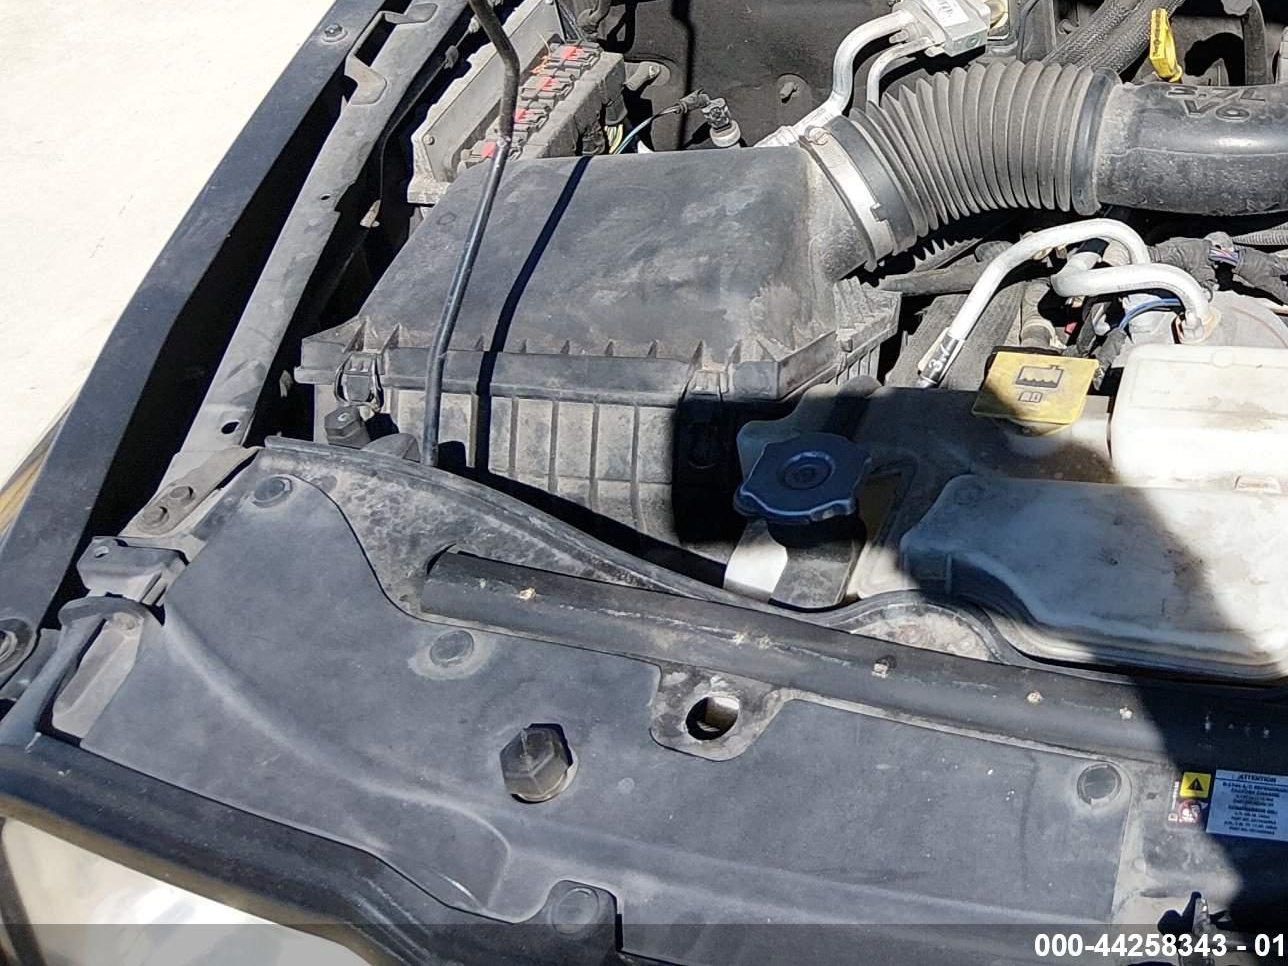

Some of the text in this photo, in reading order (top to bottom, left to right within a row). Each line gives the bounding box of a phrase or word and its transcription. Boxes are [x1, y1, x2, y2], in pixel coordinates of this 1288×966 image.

[1167, 85, 1266, 103] 3.7L
[1183, 99, 1251, 122] V6
[1236, 774, 1277, 783] ATTENTION
